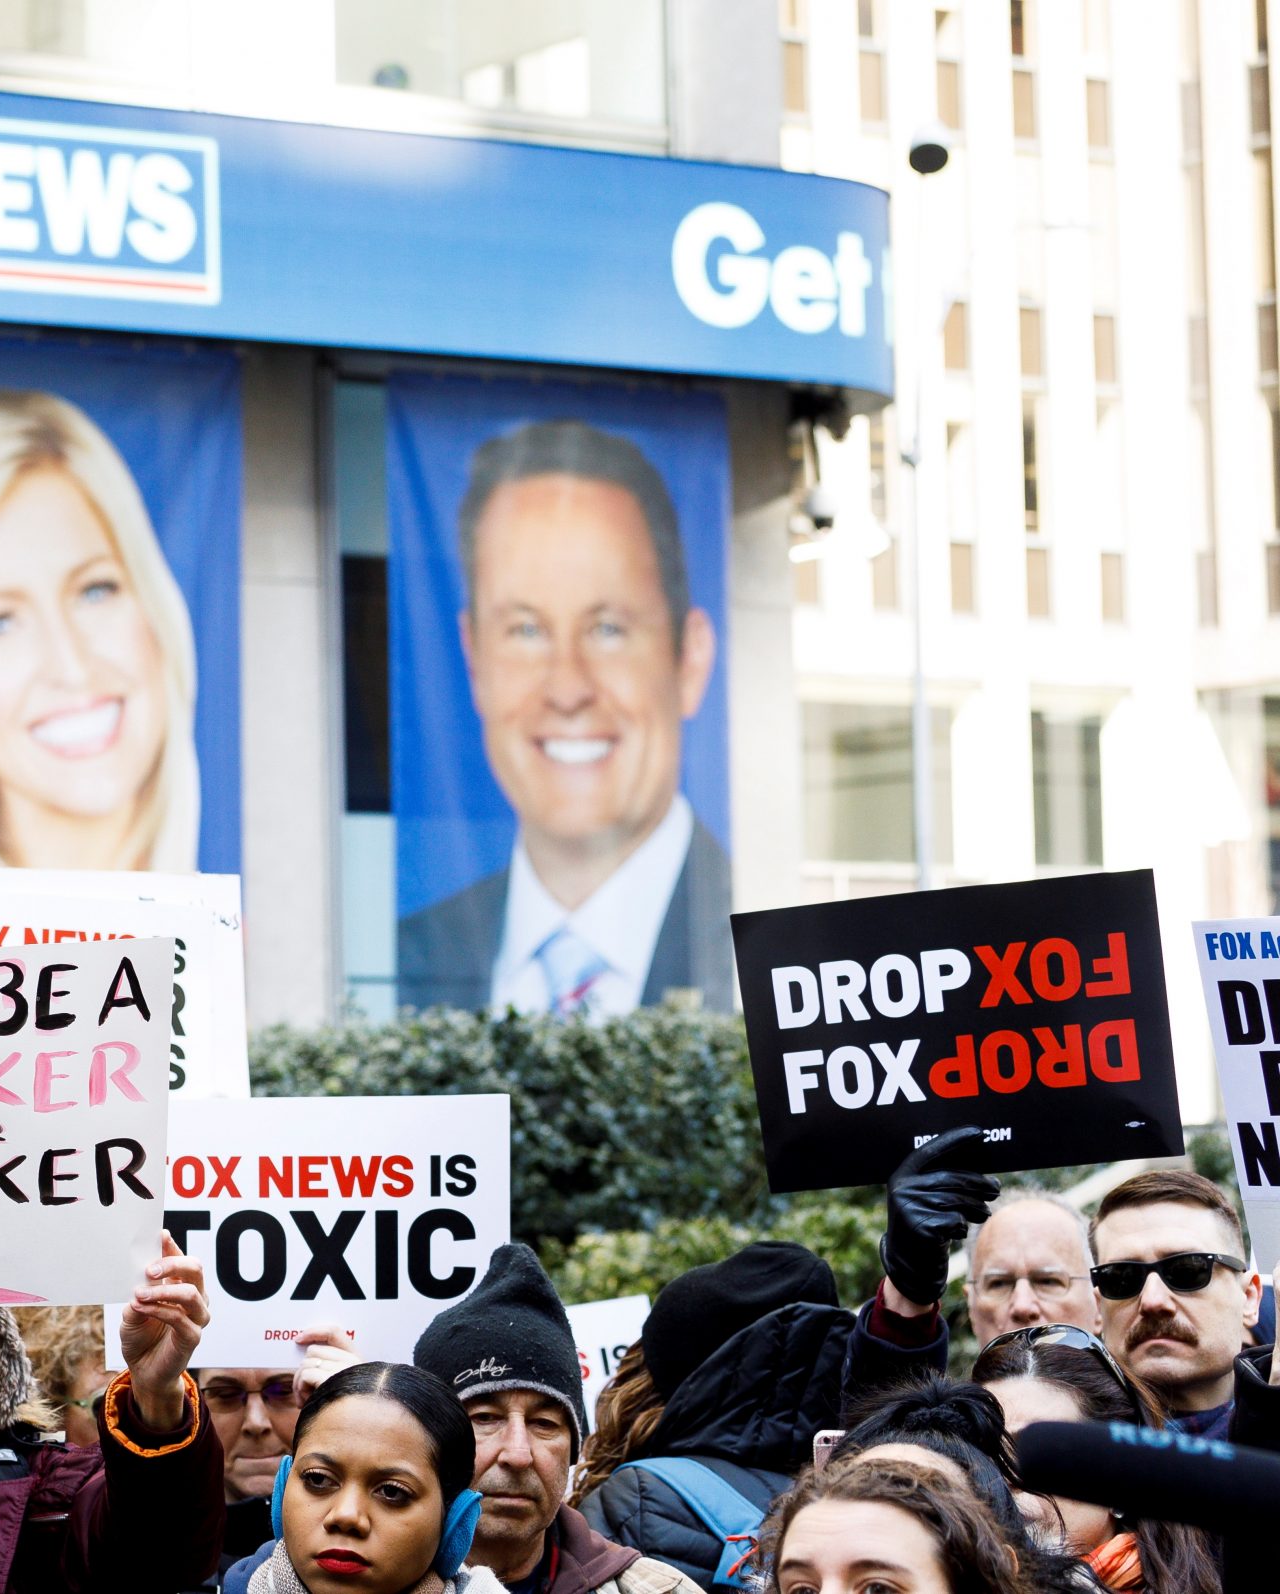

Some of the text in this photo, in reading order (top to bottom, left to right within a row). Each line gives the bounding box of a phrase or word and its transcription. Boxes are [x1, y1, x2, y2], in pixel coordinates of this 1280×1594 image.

[671, 201, 872, 338] Get
[973, 931, 1132, 1009] FOX
[1205, 931, 1256, 961] FOX
[98, 956, 152, 1027] A
[771, 948, 972, 1030] DROP
[783, 1038, 927, 1114] FOX
[928, 1018, 1142, 1099] DROP
[166, 1154, 477, 1199] OX NEWS IS
[163, 1208, 477, 1301] TOXIC
